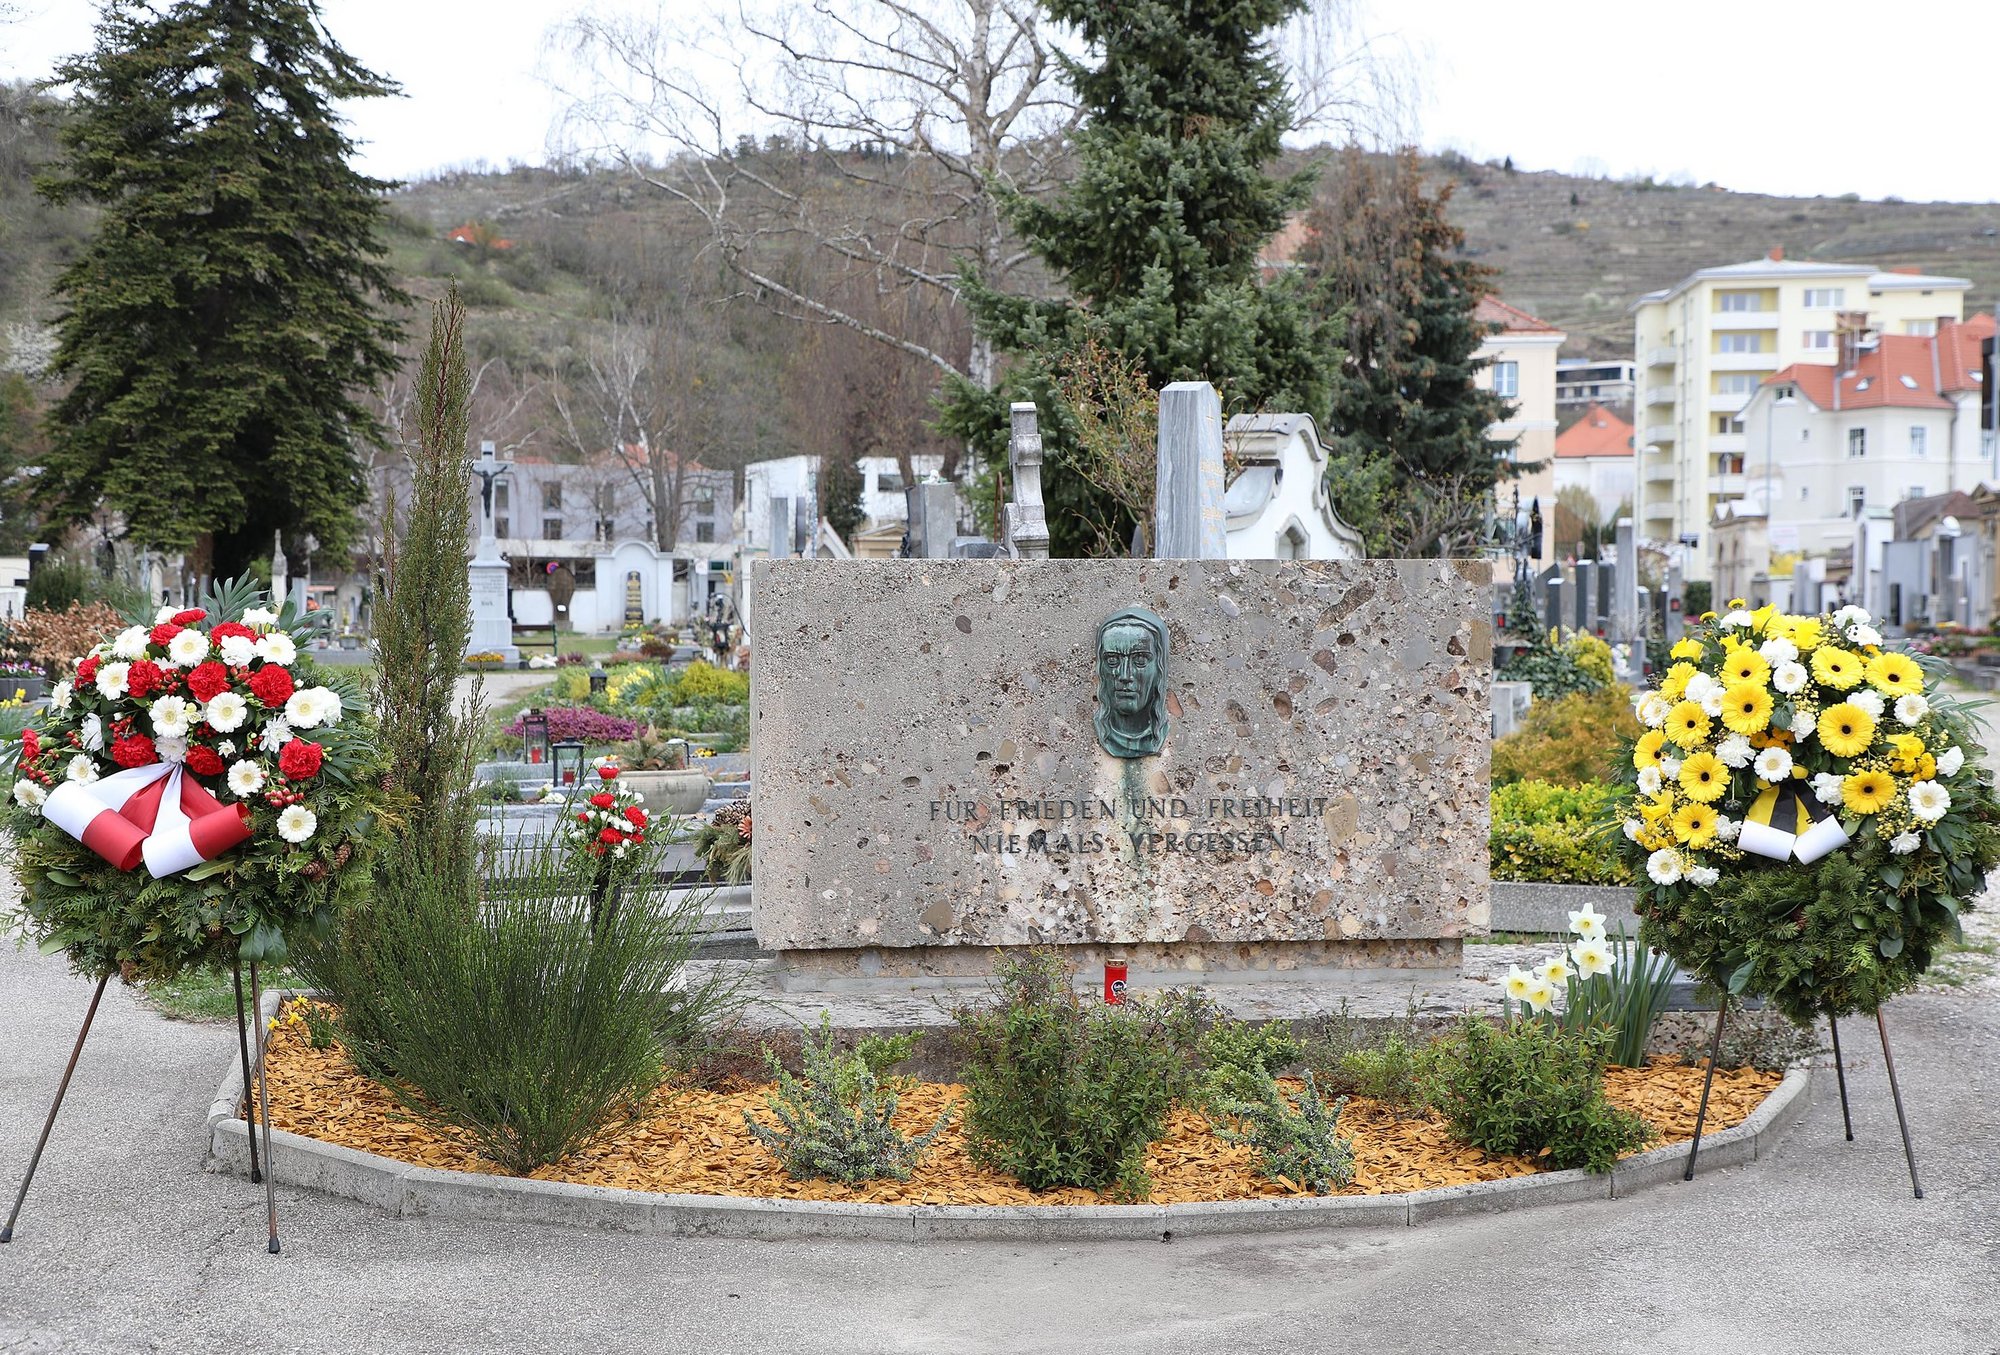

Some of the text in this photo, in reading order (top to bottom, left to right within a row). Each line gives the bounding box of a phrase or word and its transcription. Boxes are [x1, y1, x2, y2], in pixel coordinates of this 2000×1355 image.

[1000, 799, 1116, 820] FRIEDEN
[1132, 798, 1188, 819] UND
[1208, 797, 1328, 818] FREIHEIT
[970, 831, 1286, 855] NIEMALS VERGESSEN
